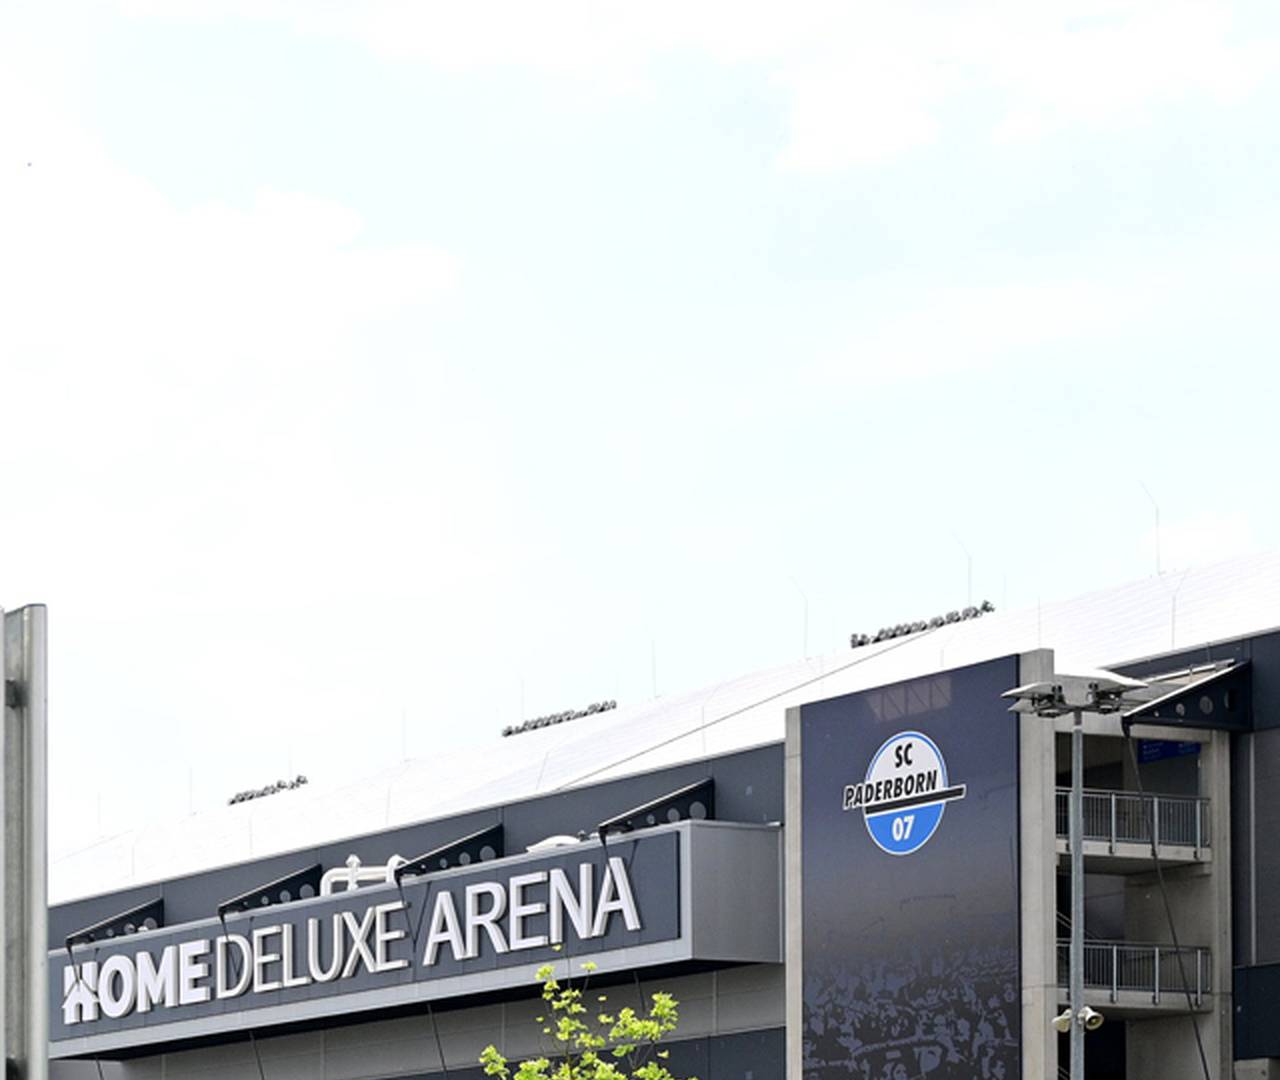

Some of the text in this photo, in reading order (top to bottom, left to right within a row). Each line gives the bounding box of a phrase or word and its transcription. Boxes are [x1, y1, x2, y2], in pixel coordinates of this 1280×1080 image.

[894, 743, 913, 768] SC
[843, 769, 938, 810] PADERBORN
[892, 815, 915, 842] 07
[422, 856, 642, 967] ARENA
